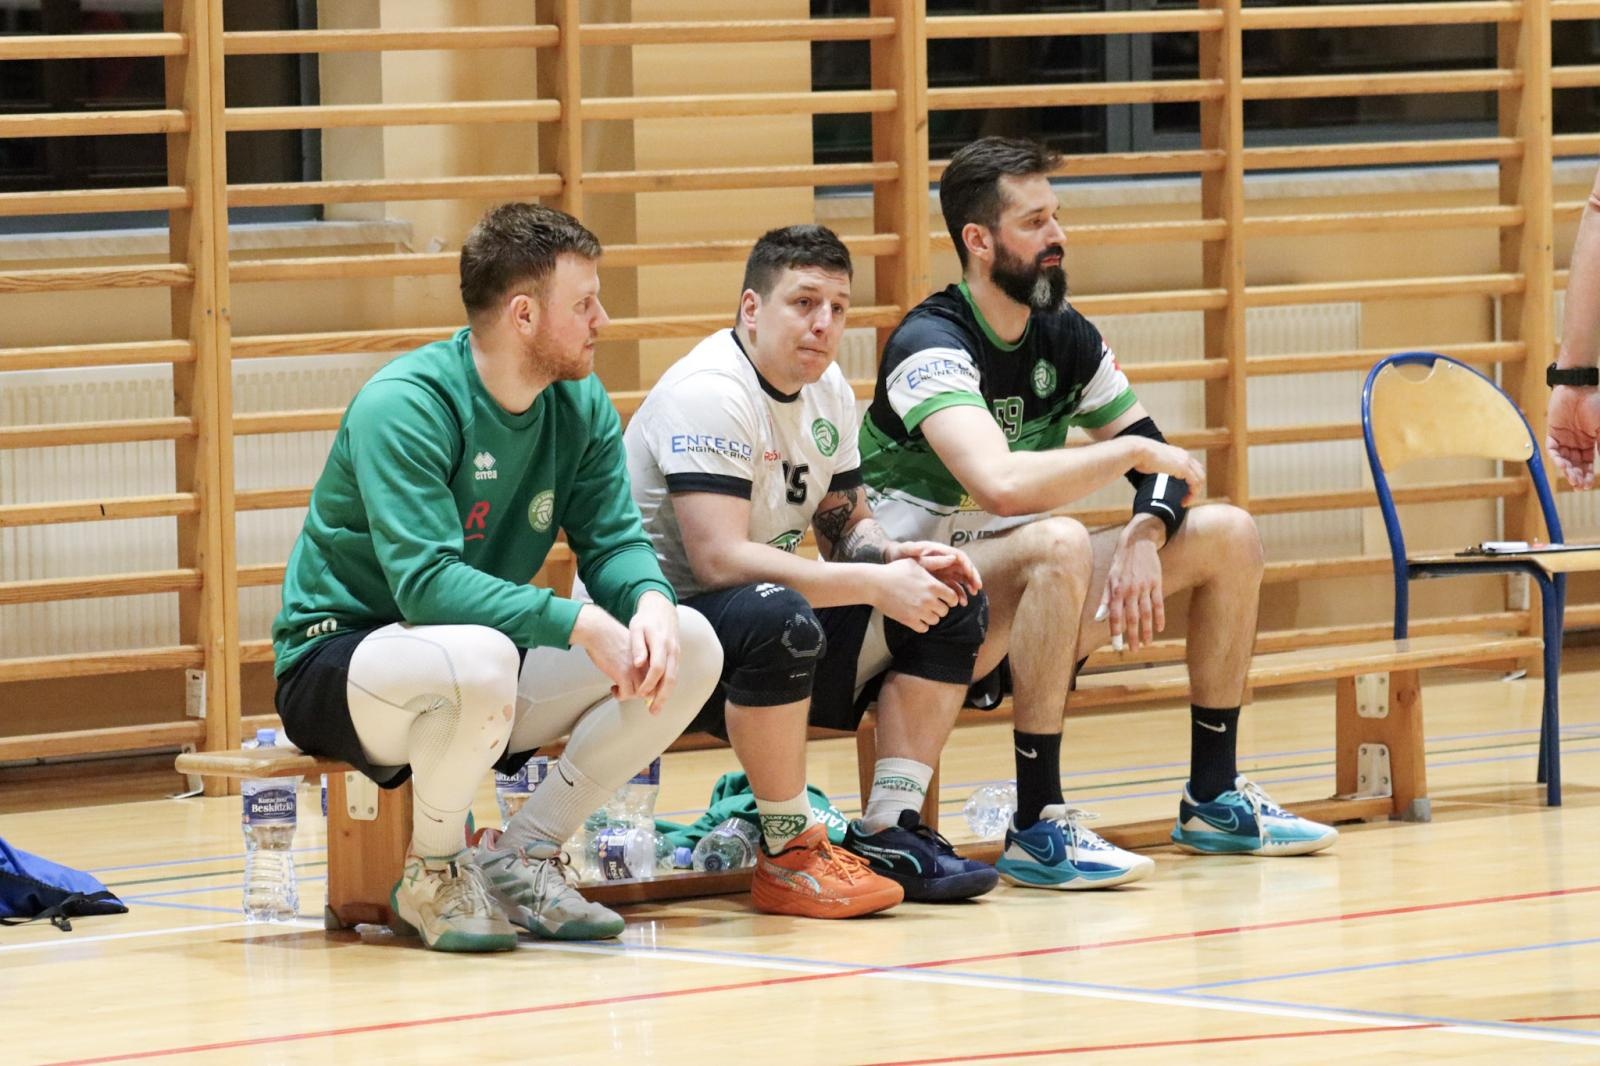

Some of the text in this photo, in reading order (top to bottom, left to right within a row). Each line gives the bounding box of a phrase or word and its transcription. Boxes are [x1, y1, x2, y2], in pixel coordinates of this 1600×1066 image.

[672, 434, 752, 456] ENTECO
[474, 470, 498, 480] errea
[782, 460, 809, 506] 15
[252, 802, 294, 813] Beskidzki
